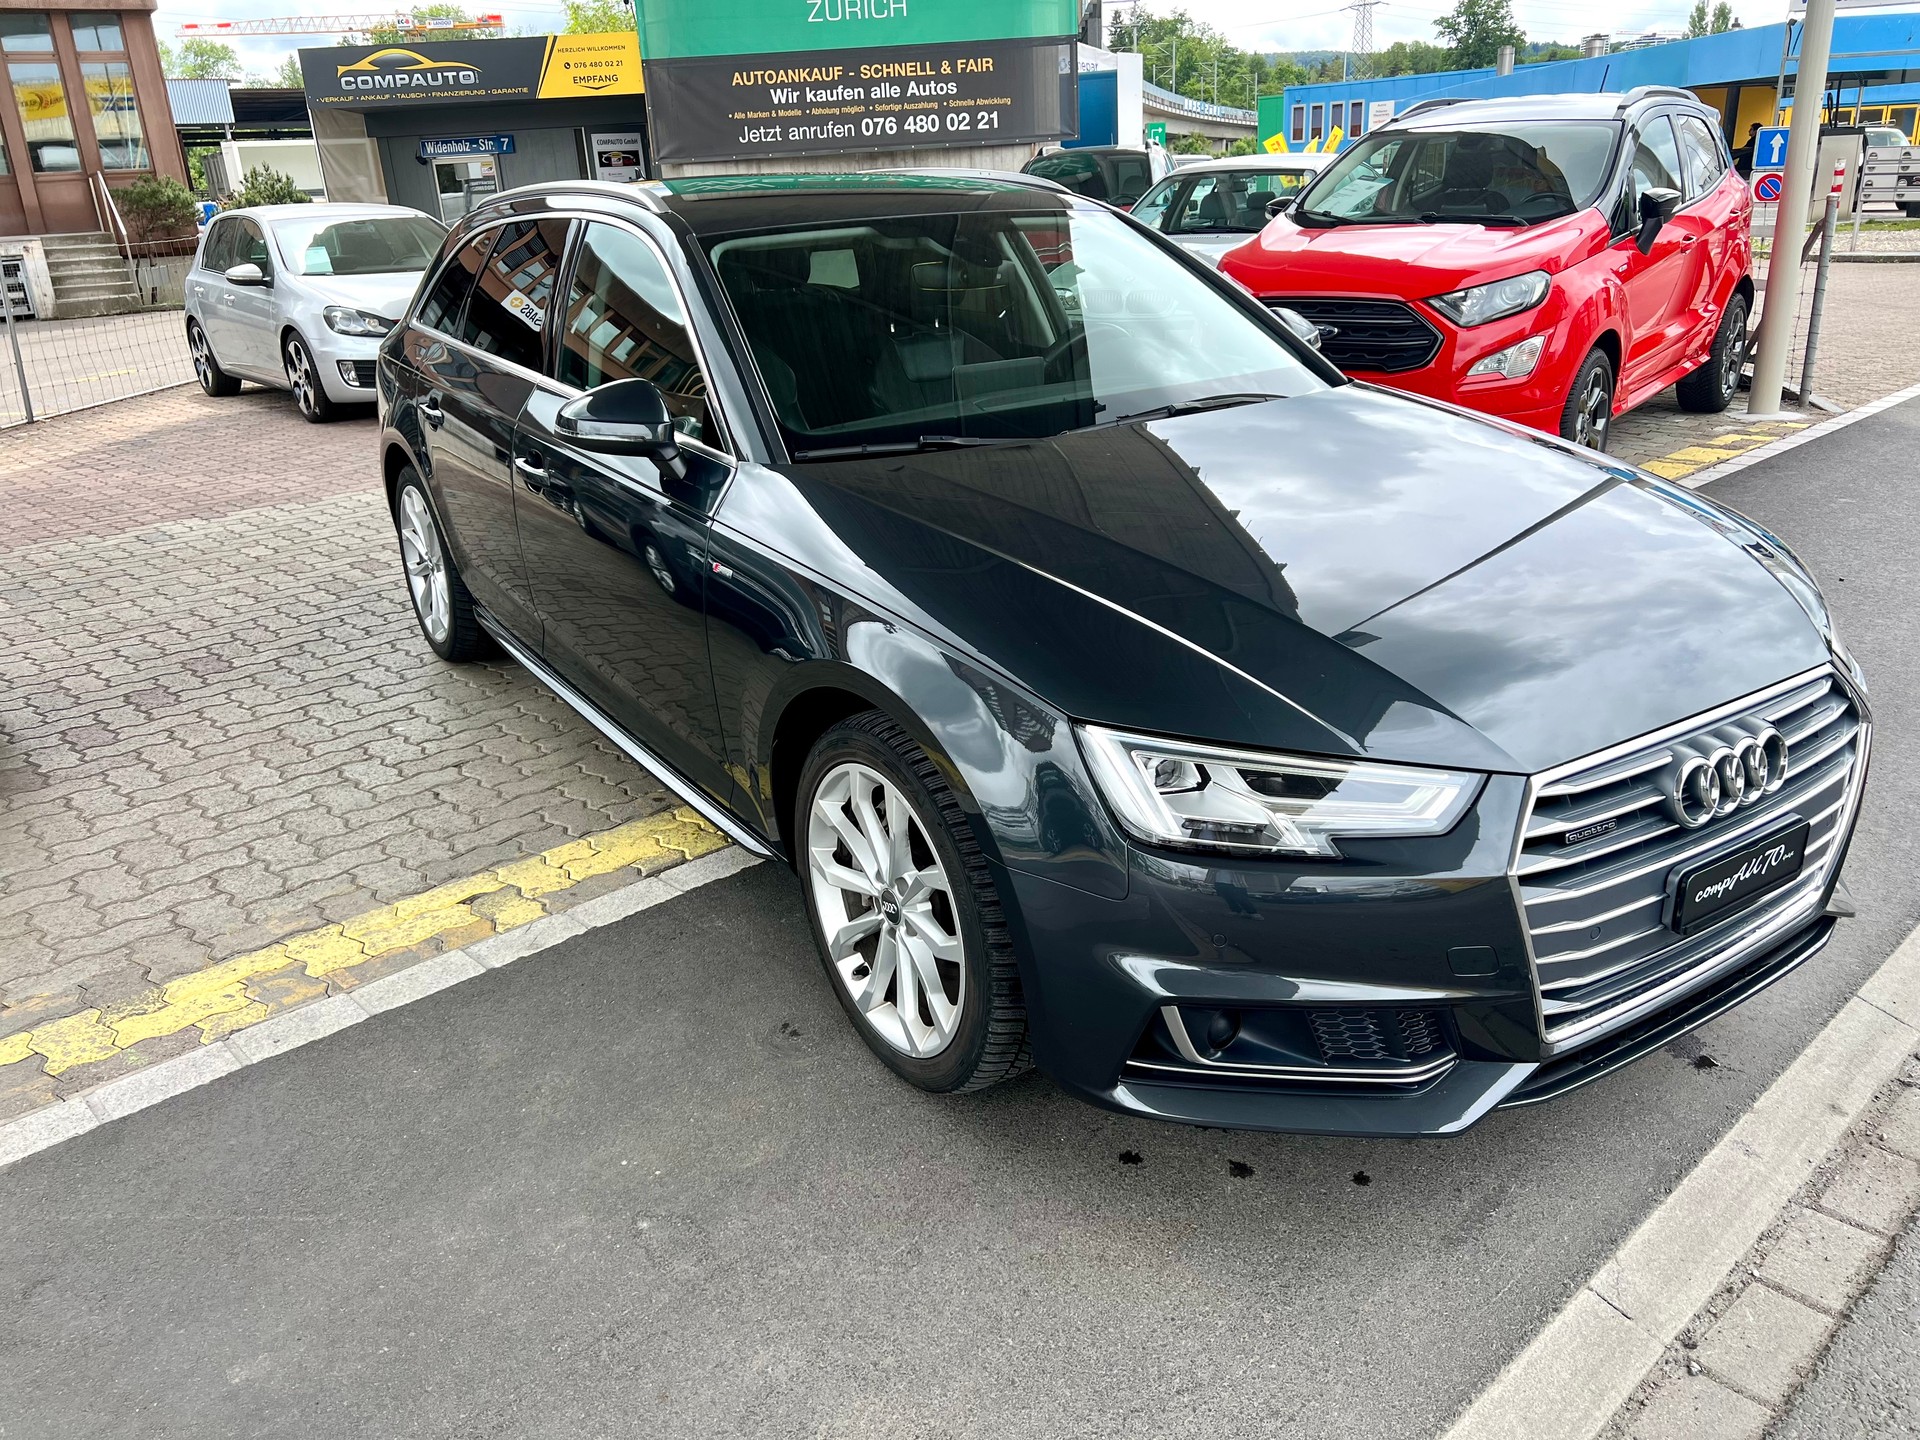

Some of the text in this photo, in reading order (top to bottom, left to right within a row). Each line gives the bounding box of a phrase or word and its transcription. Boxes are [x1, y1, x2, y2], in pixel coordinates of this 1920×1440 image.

[573, 61, 587, 69] 076
[589, 60, 603, 68] 480
[732, 66, 843, 86] AUTOANKAUF
[860, 61, 936, 79] SCHNELL
[940, 60, 952, 74] &
[957, 58, 994, 73] FAIR
[340, 70, 476, 91] COMPAUTO
[573, 74, 619, 84] EMPFANG
[432, 89, 486, 97] FINANZIERUNG
[769, 80, 958, 104] Wir kaufen alle Autos
[747, 110, 770, 119] Marken
[778, 108, 802, 117] Modelle
[811, 106, 840, 115] Abholung
[841, 105, 866, 114] möglich
[874, 103, 902, 112] Sofortige
[903, 101, 939, 110] Auszahlung
[948, 99, 975, 107] Schnelle
[976, 97, 1011, 106] Abwicklung
[739, 110, 999, 143] Jetzt anrufen 076 480 02 21
[425, 140, 471, 154] Widenholz
[500, 138, 509, 151] 7
[1569, 821, 1616, 841] quattro
